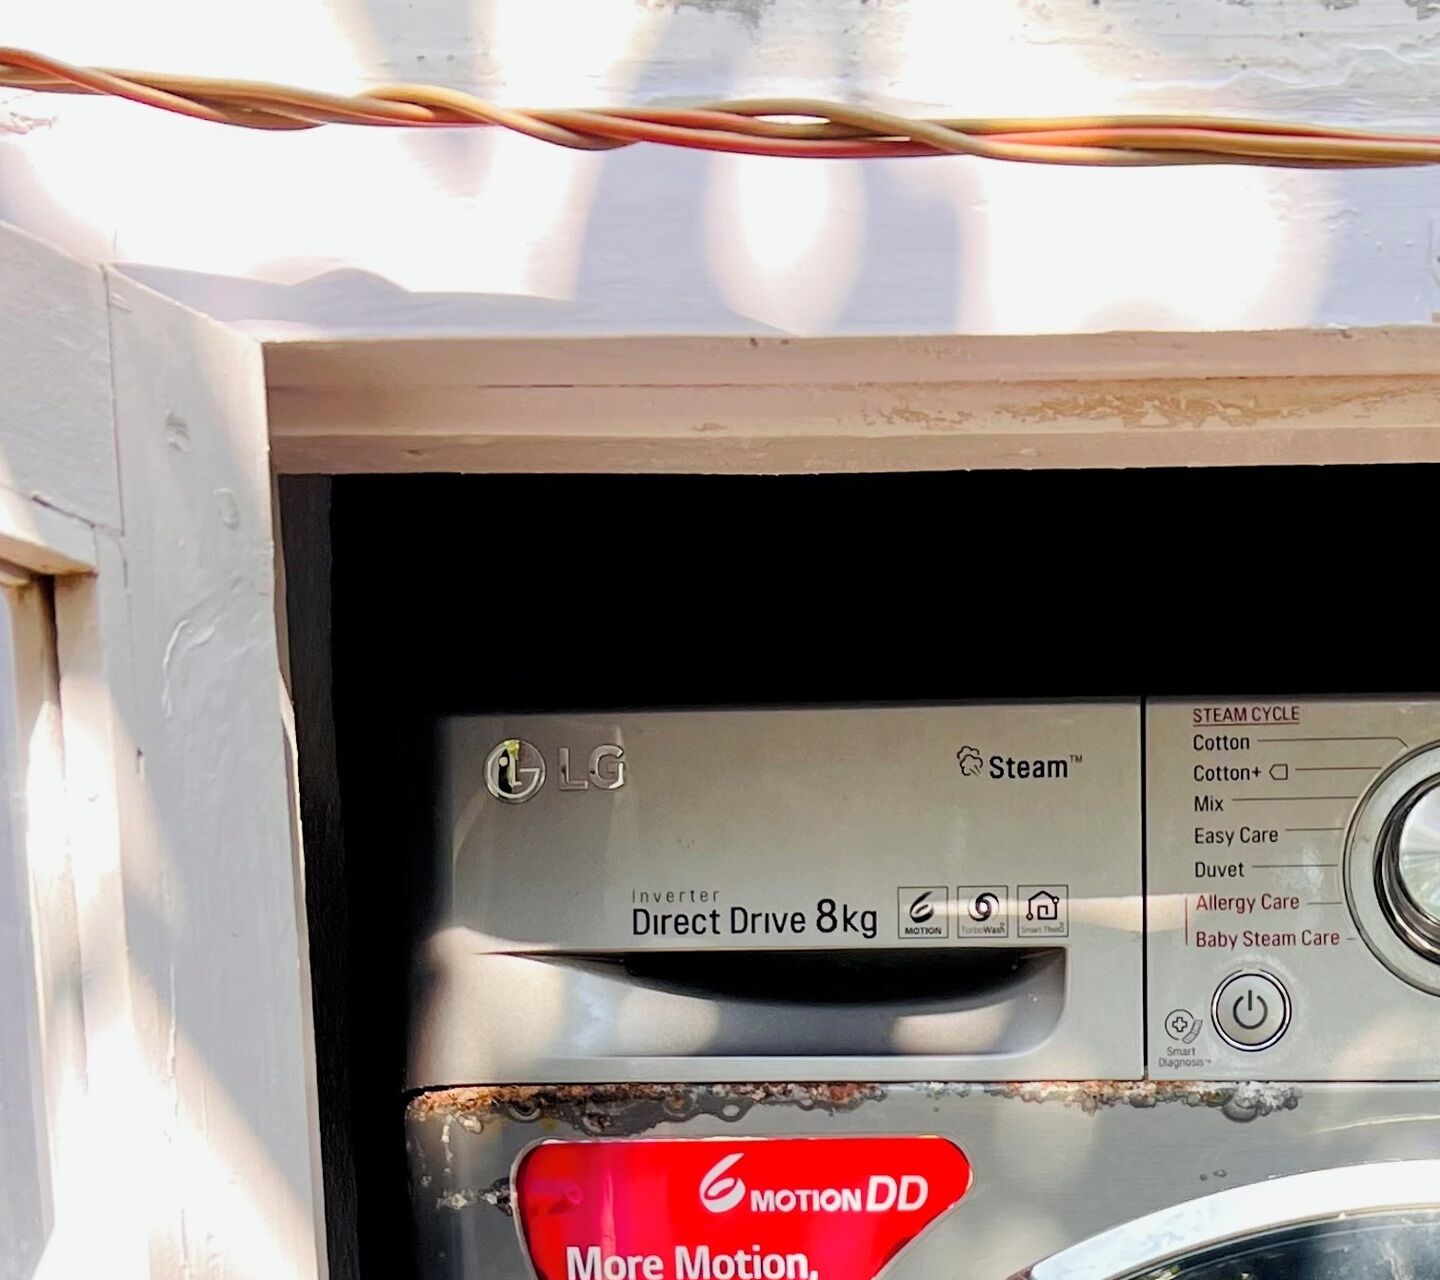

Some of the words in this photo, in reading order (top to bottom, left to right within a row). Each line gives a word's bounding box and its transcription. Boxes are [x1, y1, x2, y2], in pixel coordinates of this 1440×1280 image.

[1192, 706, 1247, 723] STEAM
[1251, 705, 1300, 721] CYCLE
[1193, 734, 1250, 751] Cotton
[558, 743, 626, 791] LG
[1193, 764, 1262, 781] Cotton+
[1194, 795, 1224, 813] Mix
[1194, 827, 1235, 847] Easy
[1239, 826, 1279, 843] Care
[1195, 860, 1245, 878] Duvet
[630, 888, 722, 904] Inverter
[1195, 893, 1256, 914] Allergy
[1261, 893, 1300, 910] Care
[631, 906, 721, 936] Direct
[730, 904, 807, 935] Drive
[903, 926, 942, 936] MOTION
[1196, 930, 1237, 950] Baby
[1242, 929, 1297, 947] Steam
[1301, 929, 1341, 946] Care
[1166, 1046, 1196, 1056] Smart
